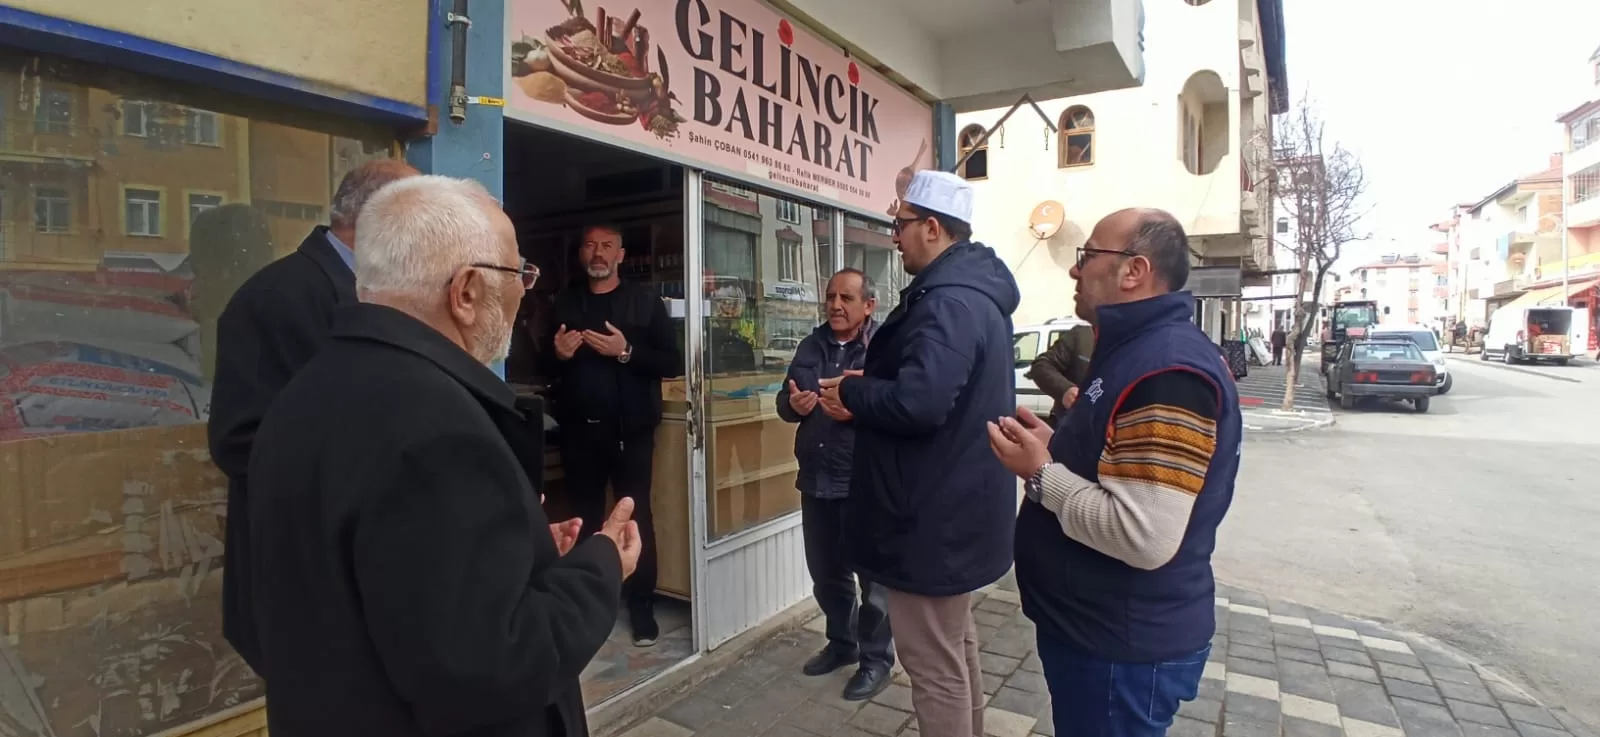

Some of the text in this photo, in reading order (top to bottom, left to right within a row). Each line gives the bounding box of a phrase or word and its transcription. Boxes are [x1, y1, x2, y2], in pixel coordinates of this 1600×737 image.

[675, 0, 880, 144] GELİNCİK
[693, 67, 873, 182] BAHARAT
[689, 131, 712, 146] Şahin
[714, 140, 741, 156] ÇOBAN
[743, 150, 759, 161] 0541
